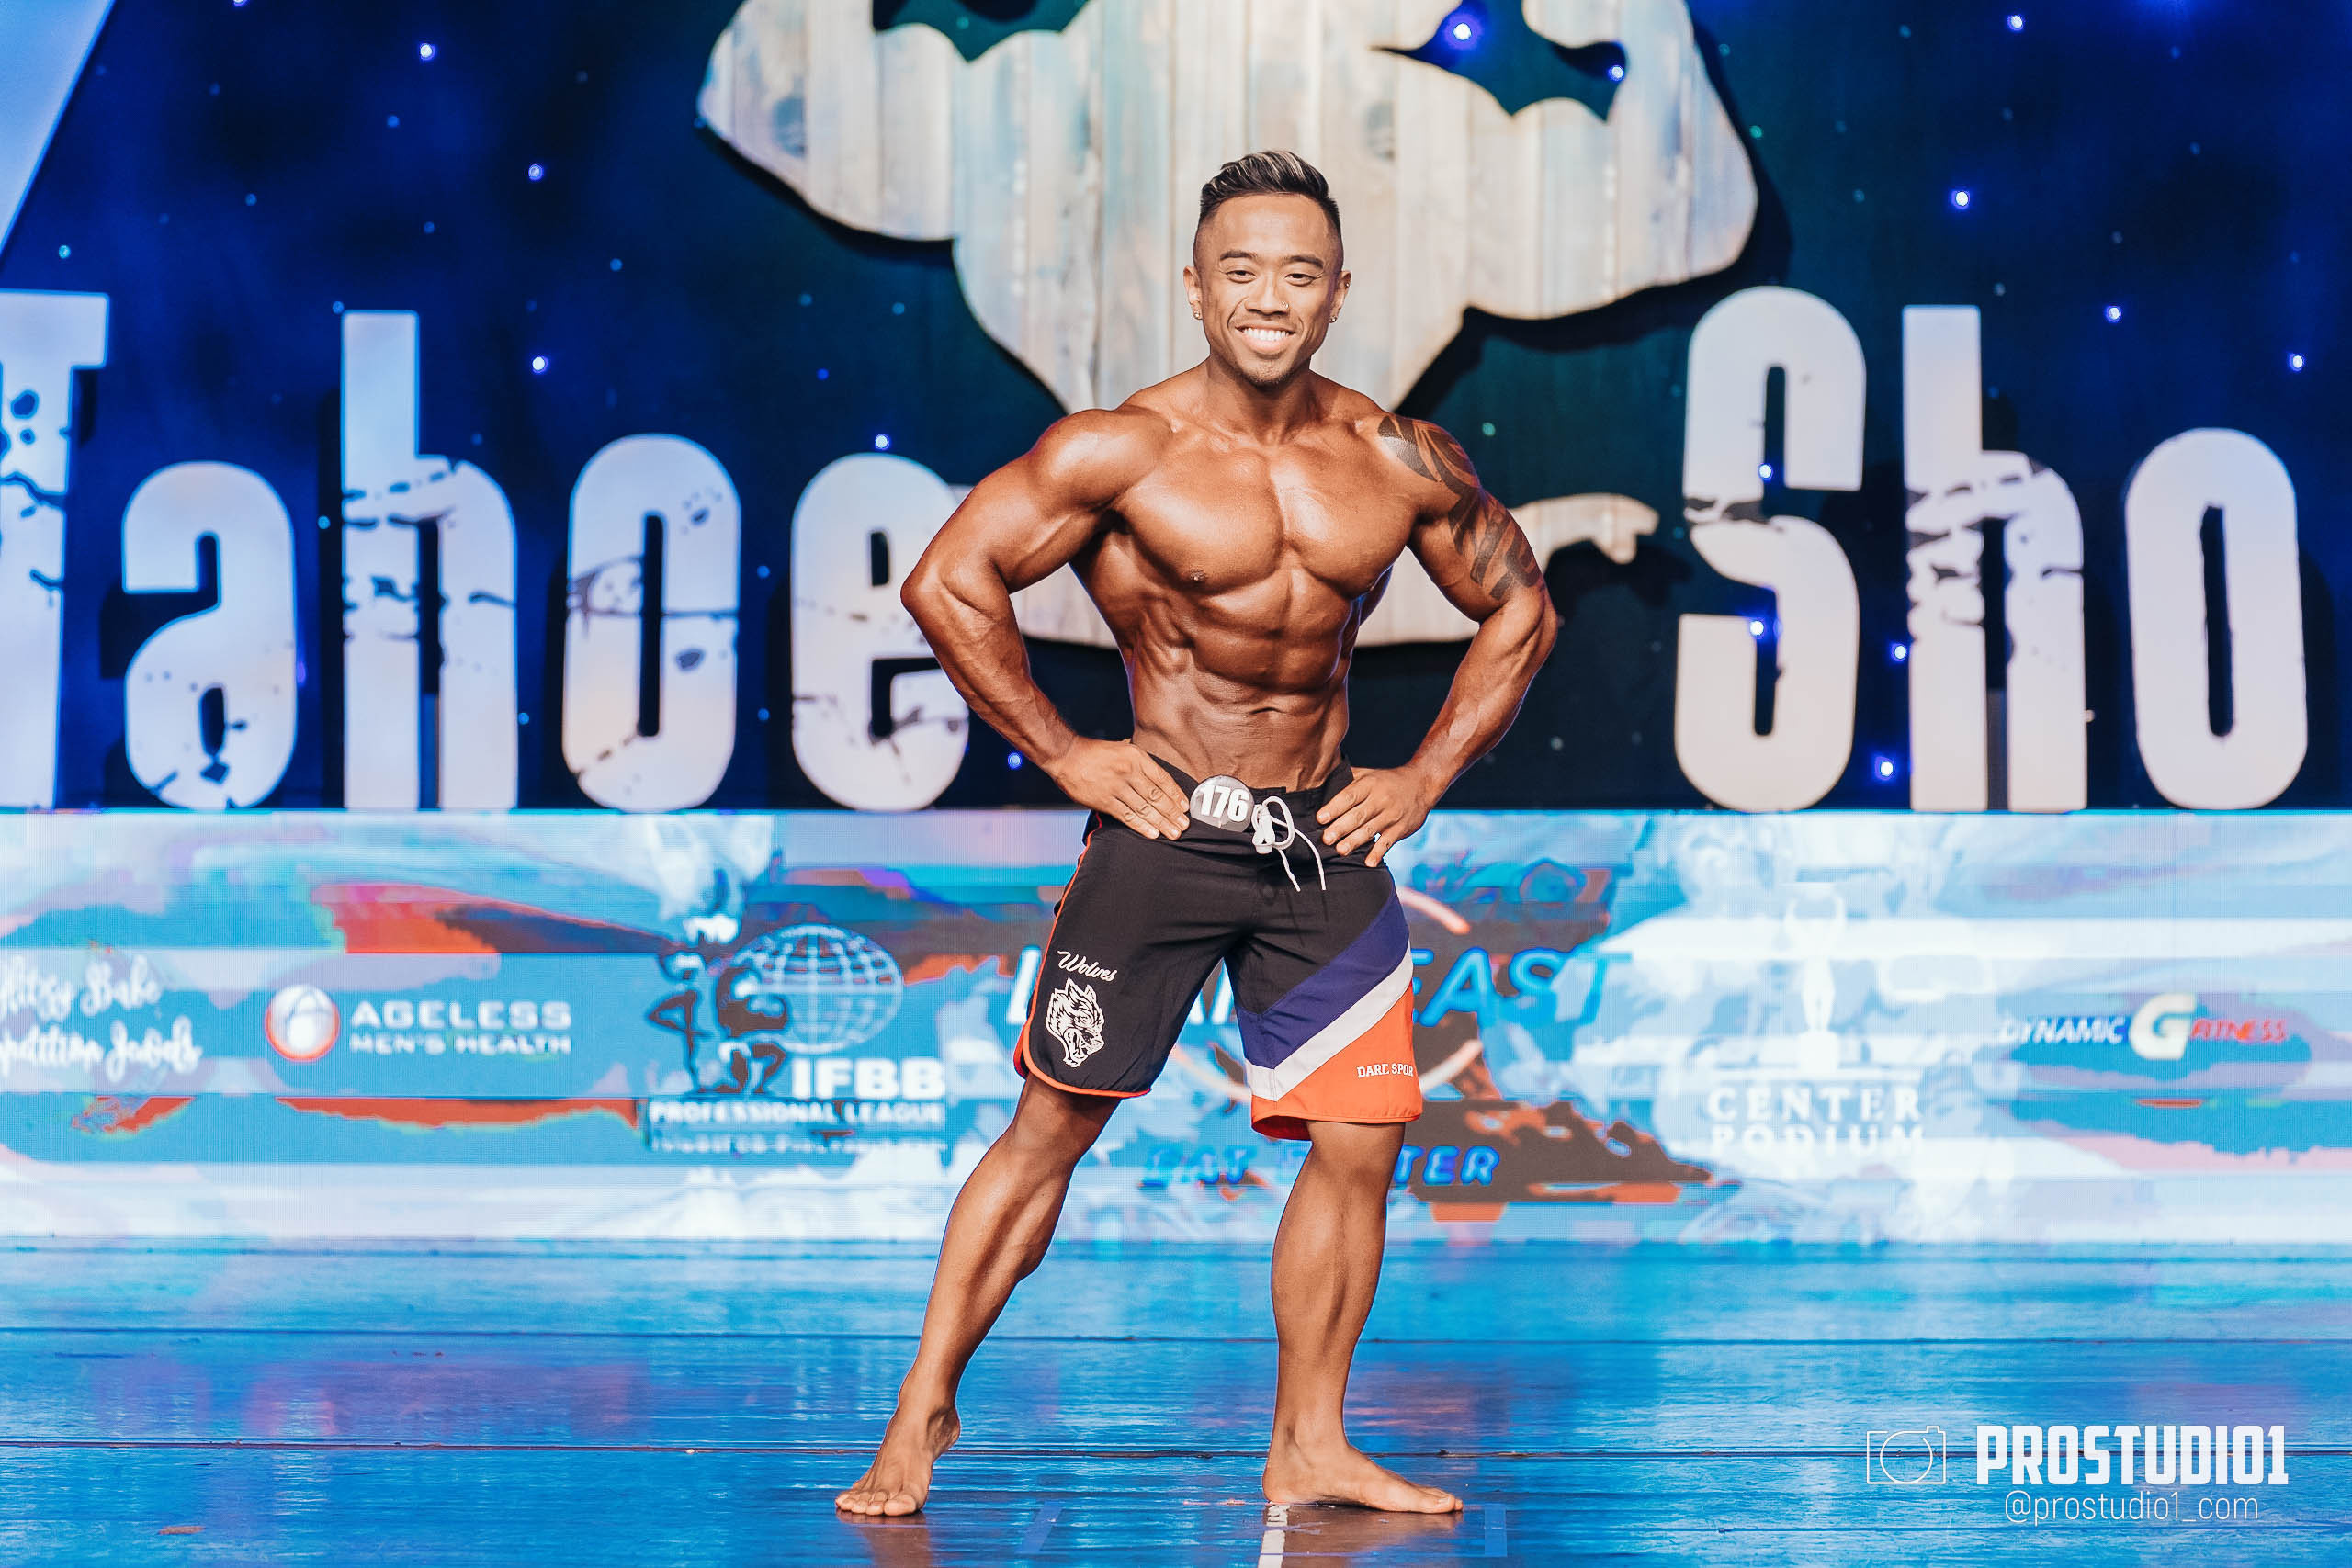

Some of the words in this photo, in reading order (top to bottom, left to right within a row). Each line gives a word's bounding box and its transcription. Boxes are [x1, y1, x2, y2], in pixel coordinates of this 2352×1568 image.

[0, 291, 970, 812] Tahoe
[1674, 286, 2309, 813] Sho
[1200, 784, 1250, 822] 176
[1057, 950, 1118, 982] Wolves
[351, 999, 572, 1031] AGELESS
[1997, 1014, 2127, 1045] DYNAMIC
[349, 1032, 447, 1055] MEN'S
[454, 1033, 572, 1055] HEALTH
[791, 1057, 947, 1100] IFBB
[649, 1101, 837, 1124] PROFESSIONAL
[842, 1101, 946, 1124] LEAGUE
[1707, 1086, 1923, 1122] CENTER
[1709, 1123, 1924, 1156] PODIUM
